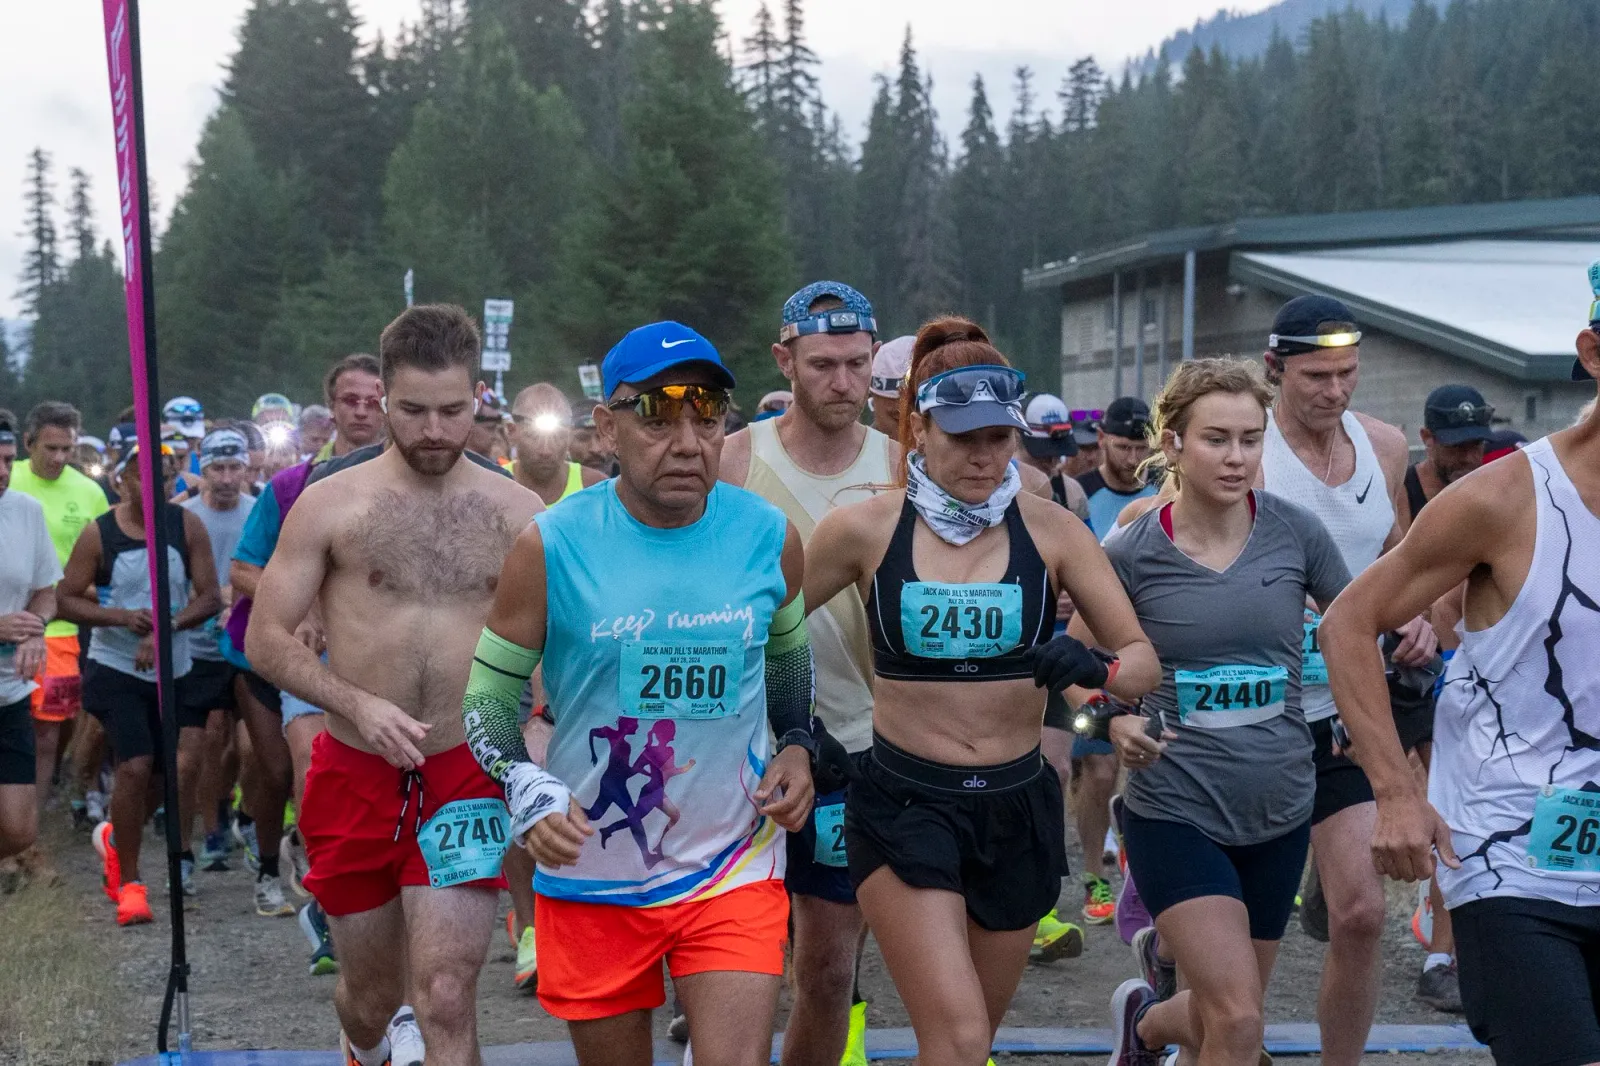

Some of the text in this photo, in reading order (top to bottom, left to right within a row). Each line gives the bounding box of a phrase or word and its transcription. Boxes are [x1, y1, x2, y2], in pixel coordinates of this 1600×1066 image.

[922, 588, 937, 596] JACK
[938, 588, 951, 596] AND
[952, 589, 968, 597] JILL'S
[667, 604, 755, 649] running
[920, 605, 1003, 640] 2430
[643, 647, 728, 655] JACK AND JILL'S MARATHON
[954, 661, 978, 673] alo
[640, 665, 726, 699] 2660
[1195, 680, 1271, 711] 2440
[963, 775, 987, 788] alo
[1562, 795, 1580, 805] JACK
[457, 804, 472, 813] JILL'S
[434, 817, 506, 852] 2740
[1551, 815, 1600, 855] 26
[444, 868, 477, 882] GEAR CHECK
